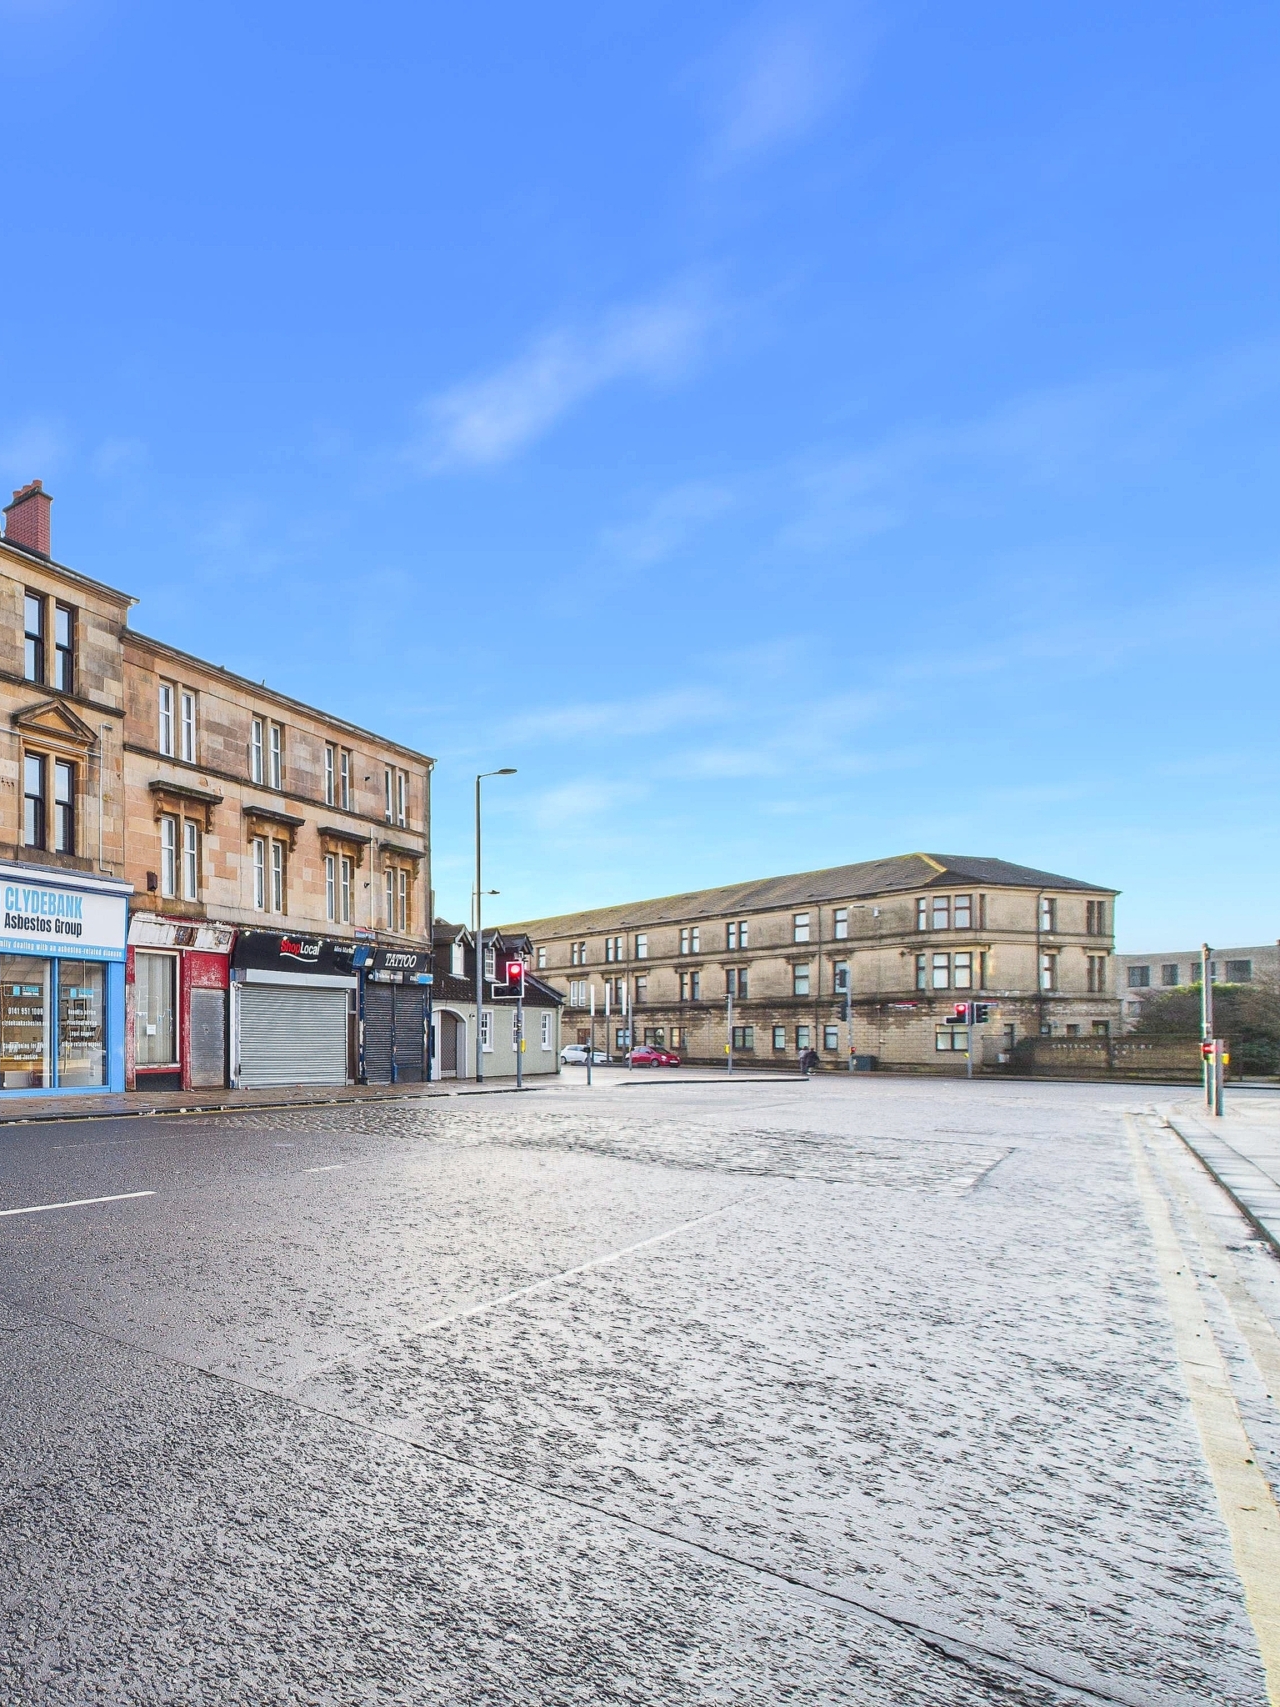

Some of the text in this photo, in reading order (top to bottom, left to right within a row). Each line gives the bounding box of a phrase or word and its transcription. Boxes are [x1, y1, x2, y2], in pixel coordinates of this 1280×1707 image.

[5, 886, 83, 919] CLYDEBANK
[4, 912, 82, 938] Asbestos Group
[13, 941, 34, 951] dealing
[36, 943, 49, 951] with
[103, 949, 122, 958] disease
[385, 953, 417, 968] TATTOO
[7, 1007, 20, 1015] 0141
[21, 1007, 31, 1015] 951
